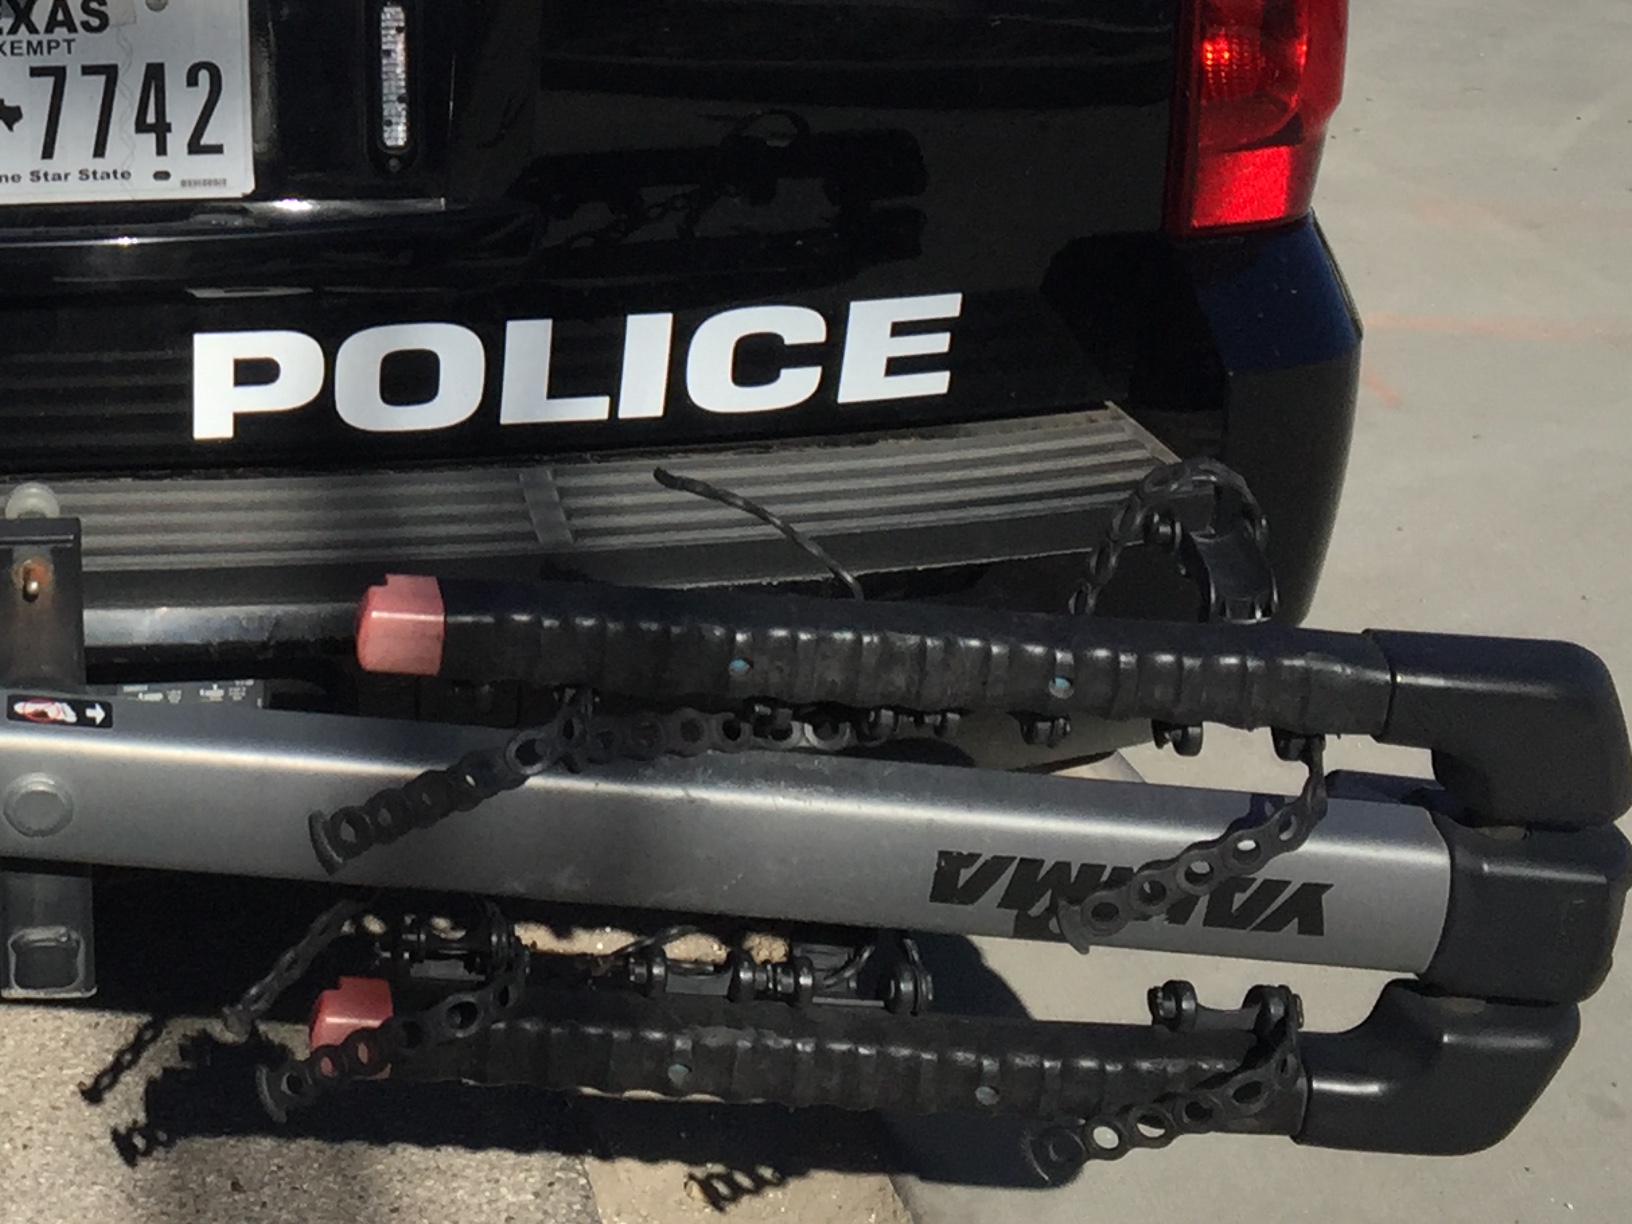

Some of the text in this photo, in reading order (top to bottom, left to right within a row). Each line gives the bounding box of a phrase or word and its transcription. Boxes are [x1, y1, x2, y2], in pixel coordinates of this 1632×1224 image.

[29, 61, 225, 161] 7742
[29, 169, 72, 183] Star
[78, 167, 132, 182] State
[192, 291, 964, 441] POLICE
